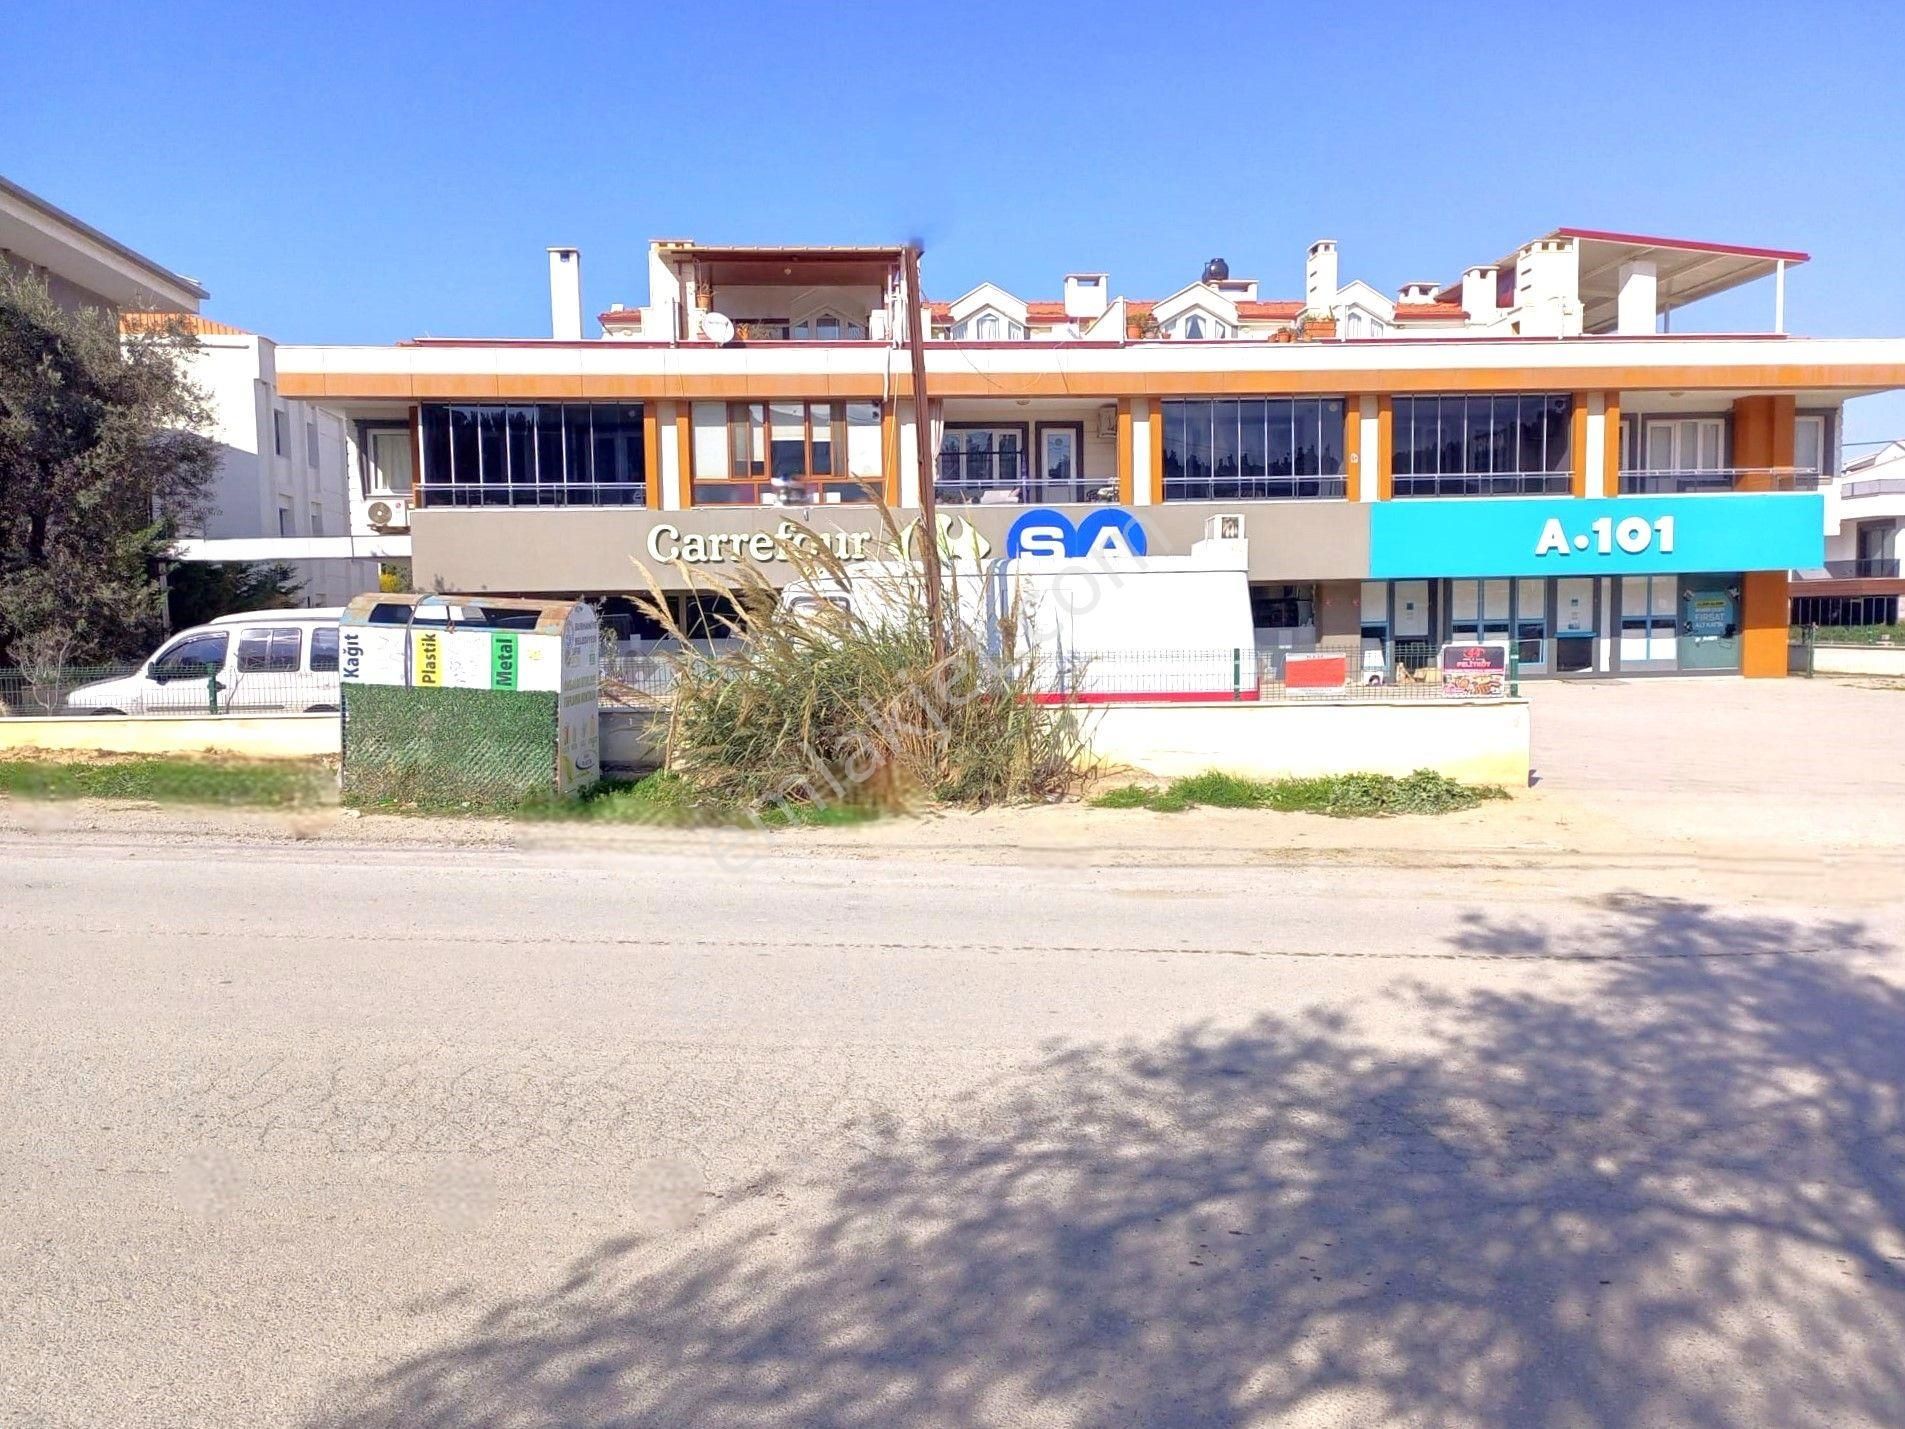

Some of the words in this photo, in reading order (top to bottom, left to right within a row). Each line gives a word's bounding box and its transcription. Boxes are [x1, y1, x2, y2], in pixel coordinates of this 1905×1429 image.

[343, 633, 364, 679] Kağıt
[421, 633, 437, 684] Plastik
[495, 638, 513, 687] Metal
